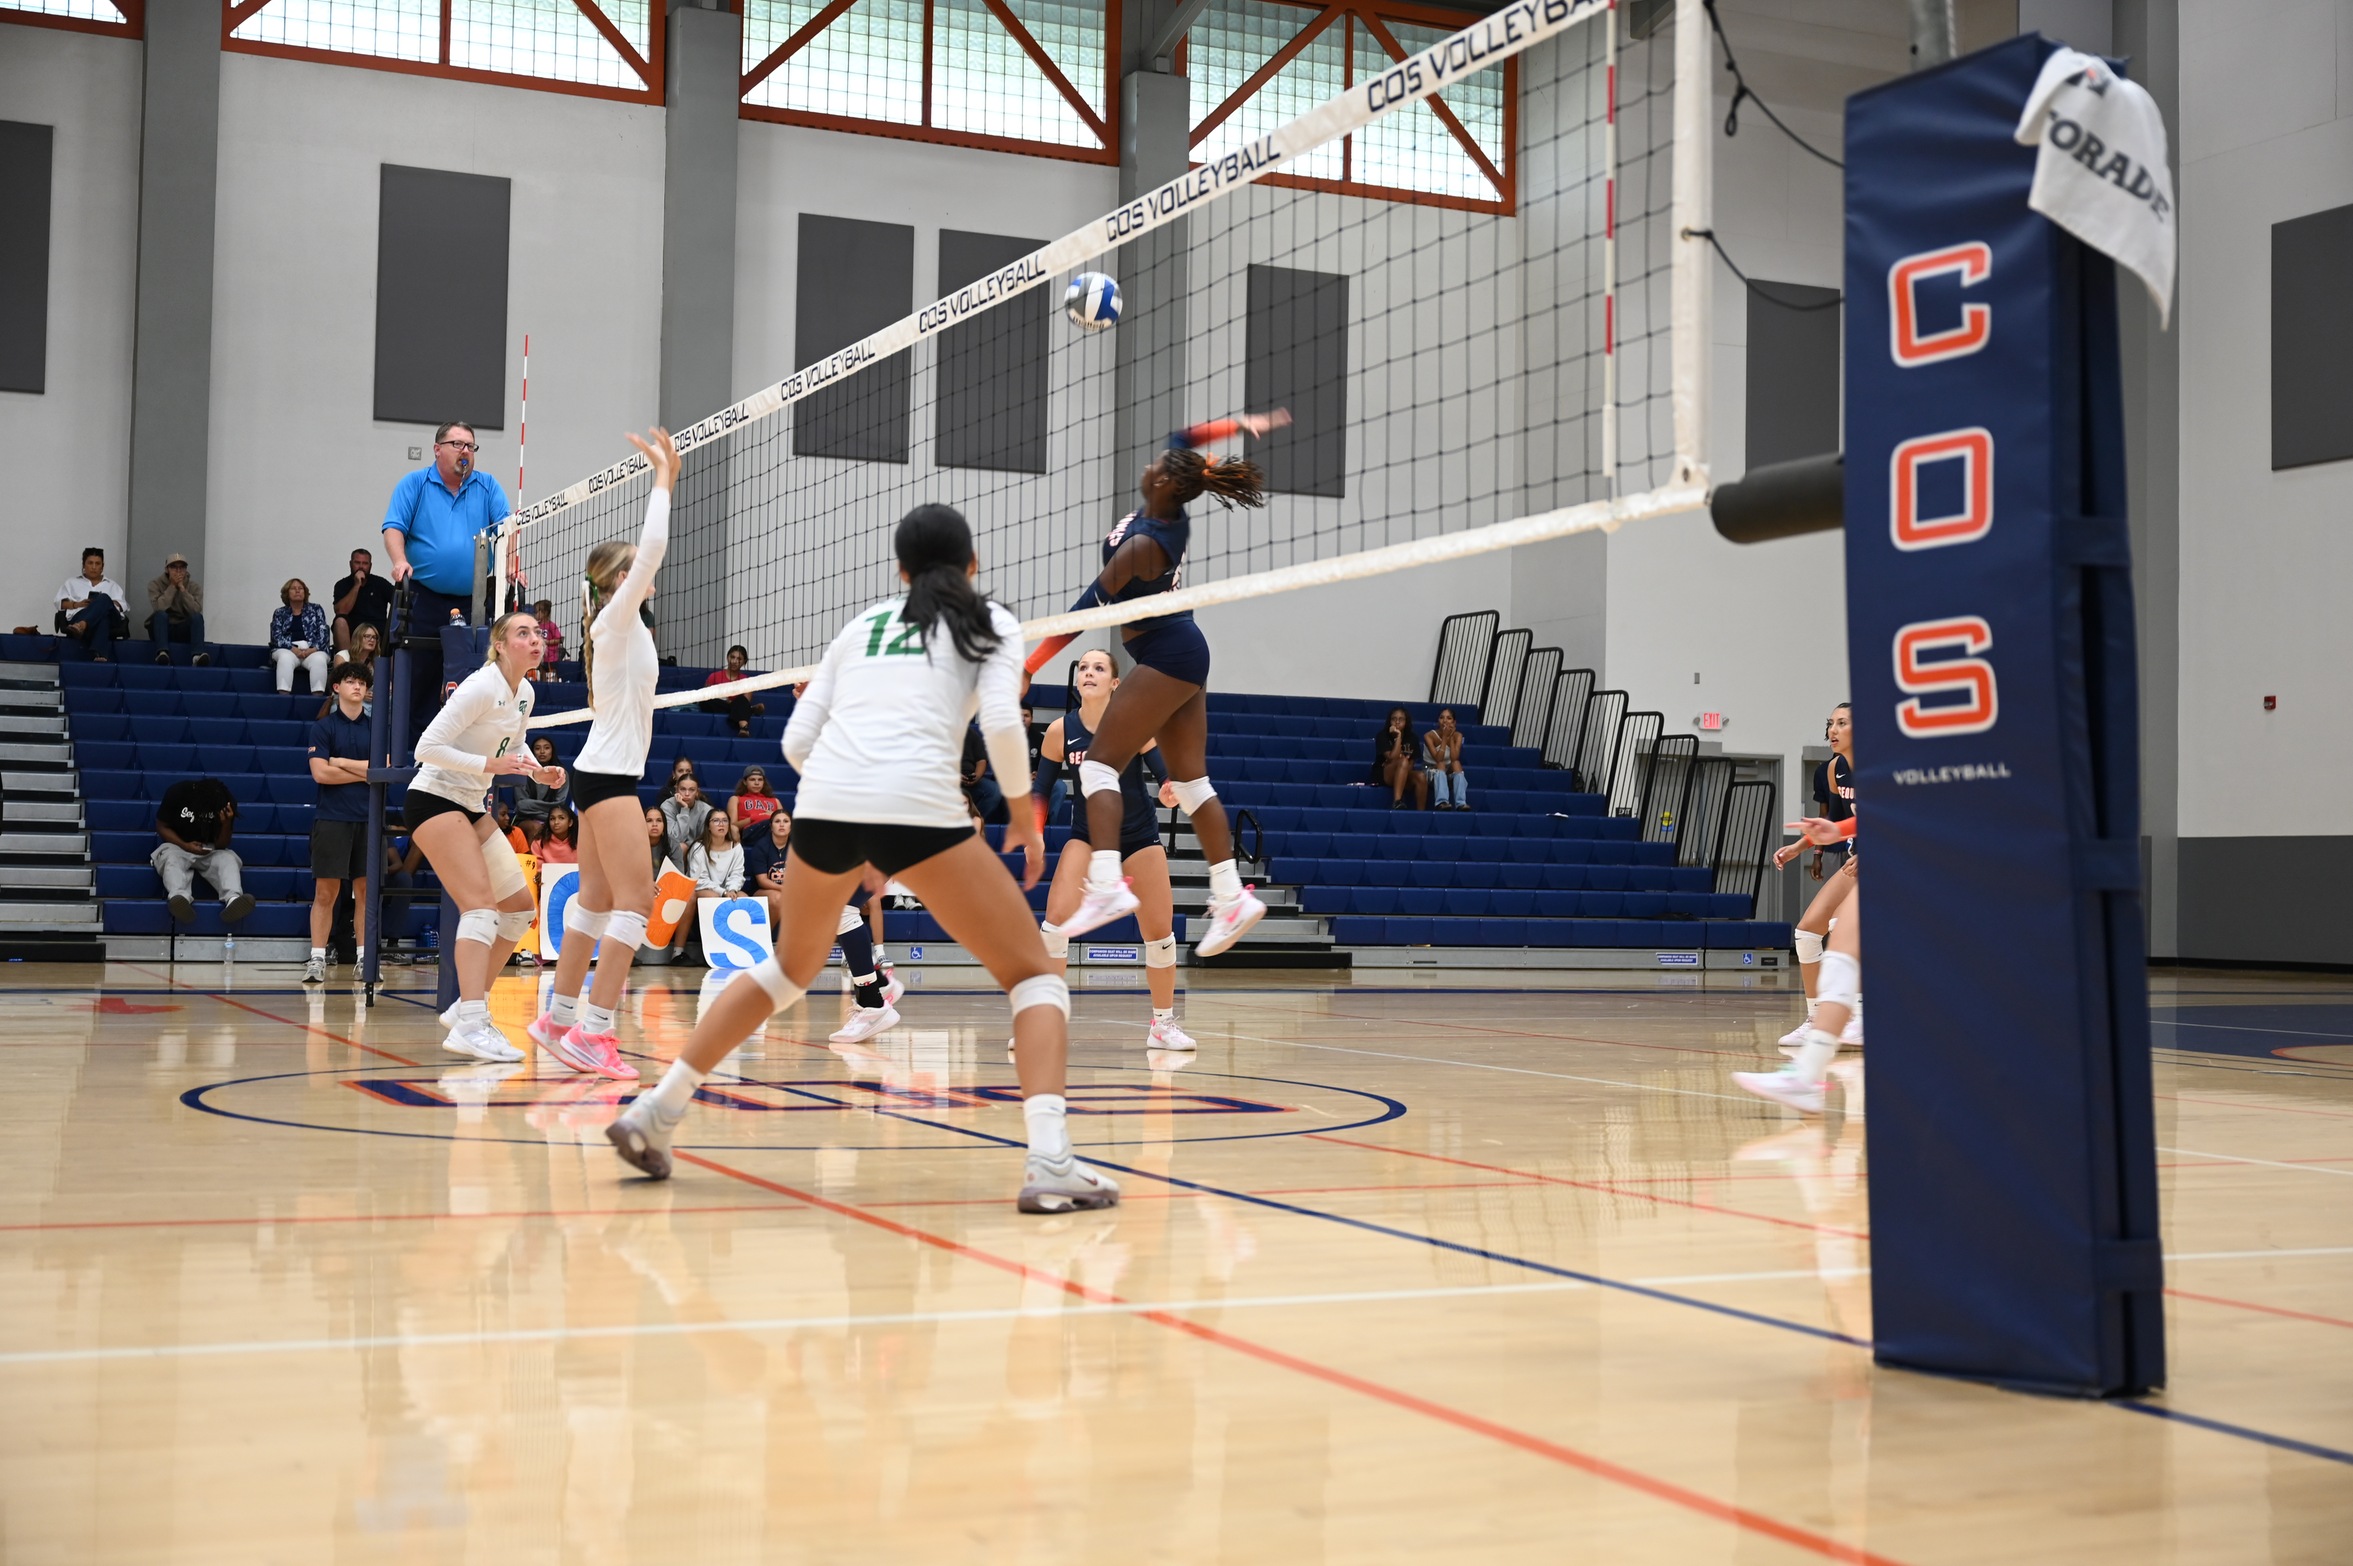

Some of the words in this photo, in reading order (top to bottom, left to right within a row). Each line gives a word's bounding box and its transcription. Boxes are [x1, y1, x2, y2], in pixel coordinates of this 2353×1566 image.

[1367, 60, 1423, 113] COS
[1106, 203, 1144, 242] COS
[1148, 135, 1281, 219] VOLLEYBALL
[919, 302, 947, 333] COS
[950, 254, 1046, 317] VOLLEYBALL
[780, 374, 802, 401] COS
[805, 339, 875, 389] VOLLEYBALL
[674, 432, 692, 451] COS
[691, 403, 749, 441] VOLLEYBALL
[588, 474, 603, 494] COS
[603, 452, 648, 486] VOLLEYBALL
[1888, 240, 1998, 738] COS
[516, 509, 531, 525] COS
[531, 492, 568, 519] VOLLEYBALL
[865, 610, 926, 657] 12
[1703, 713, 1720, 729] EXIT
[496, 737, 510, 758] 8
[1892, 762, 2011, 786] VOLLEYBALL
[745, 800, 775, 812] GAP
